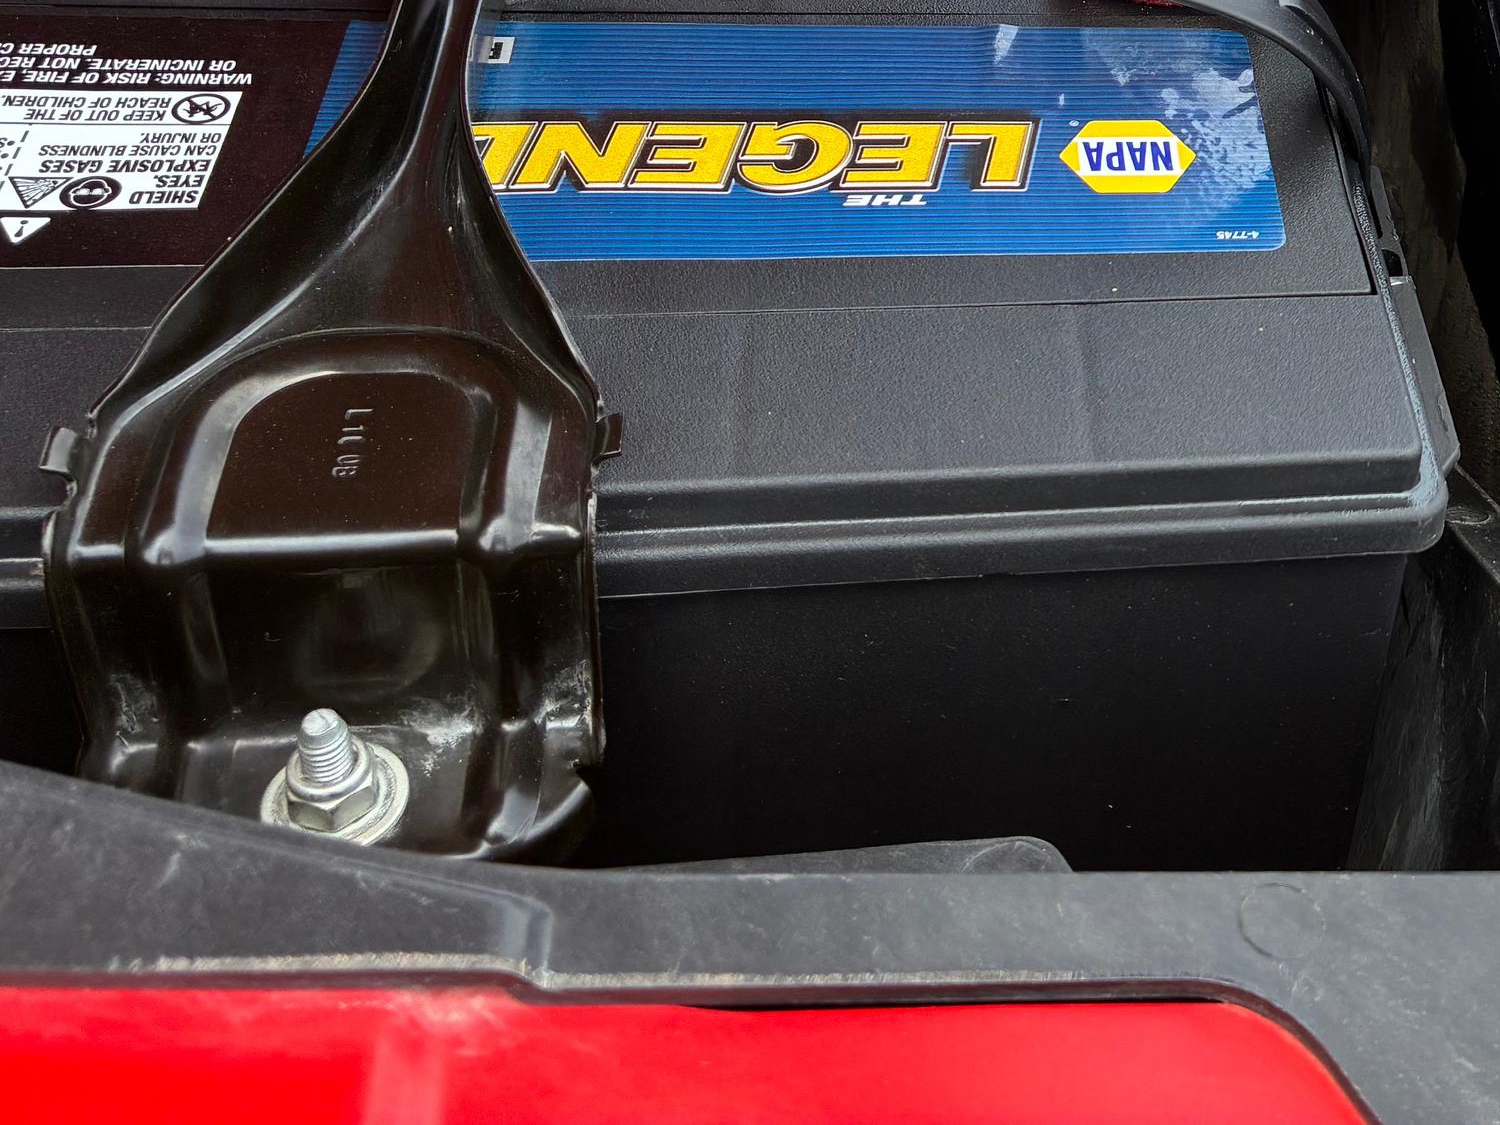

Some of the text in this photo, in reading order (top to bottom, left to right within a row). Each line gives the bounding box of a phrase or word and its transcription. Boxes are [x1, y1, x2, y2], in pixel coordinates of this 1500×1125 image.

[18, 43, 97, 56] PROPER
[37, 57, 81, 70] NOT
[86, 58, 204, 72] INCINERATE.
[208, 59, 236, 72] OR
[21, 68, 68, 83] FIRE,
[71, 72, 100, 83] OF
[103, 72, 150, 84] RISK
[154, 73, 253, 85] WARNING:
[1, 94, 172, 109] REACH OF CHILDREN.
[23, 108, 168, 122] KEEP OUT OF THE
[139, 132, 222, 144] OR INJURY.
[38, 144, 217, 157] CAN CAUSE BLINDNESS
[1079, 139, 1175, 169] NAPA
[39, 159, 212, 173] EXPLOSIVE GASES
[154, 174, 203, 188] EYES.
[129, 189, 200, 204] SHIELD
[844, 193, 927, 206] THE
[1216, 230, 1260, 240] 4-7745
